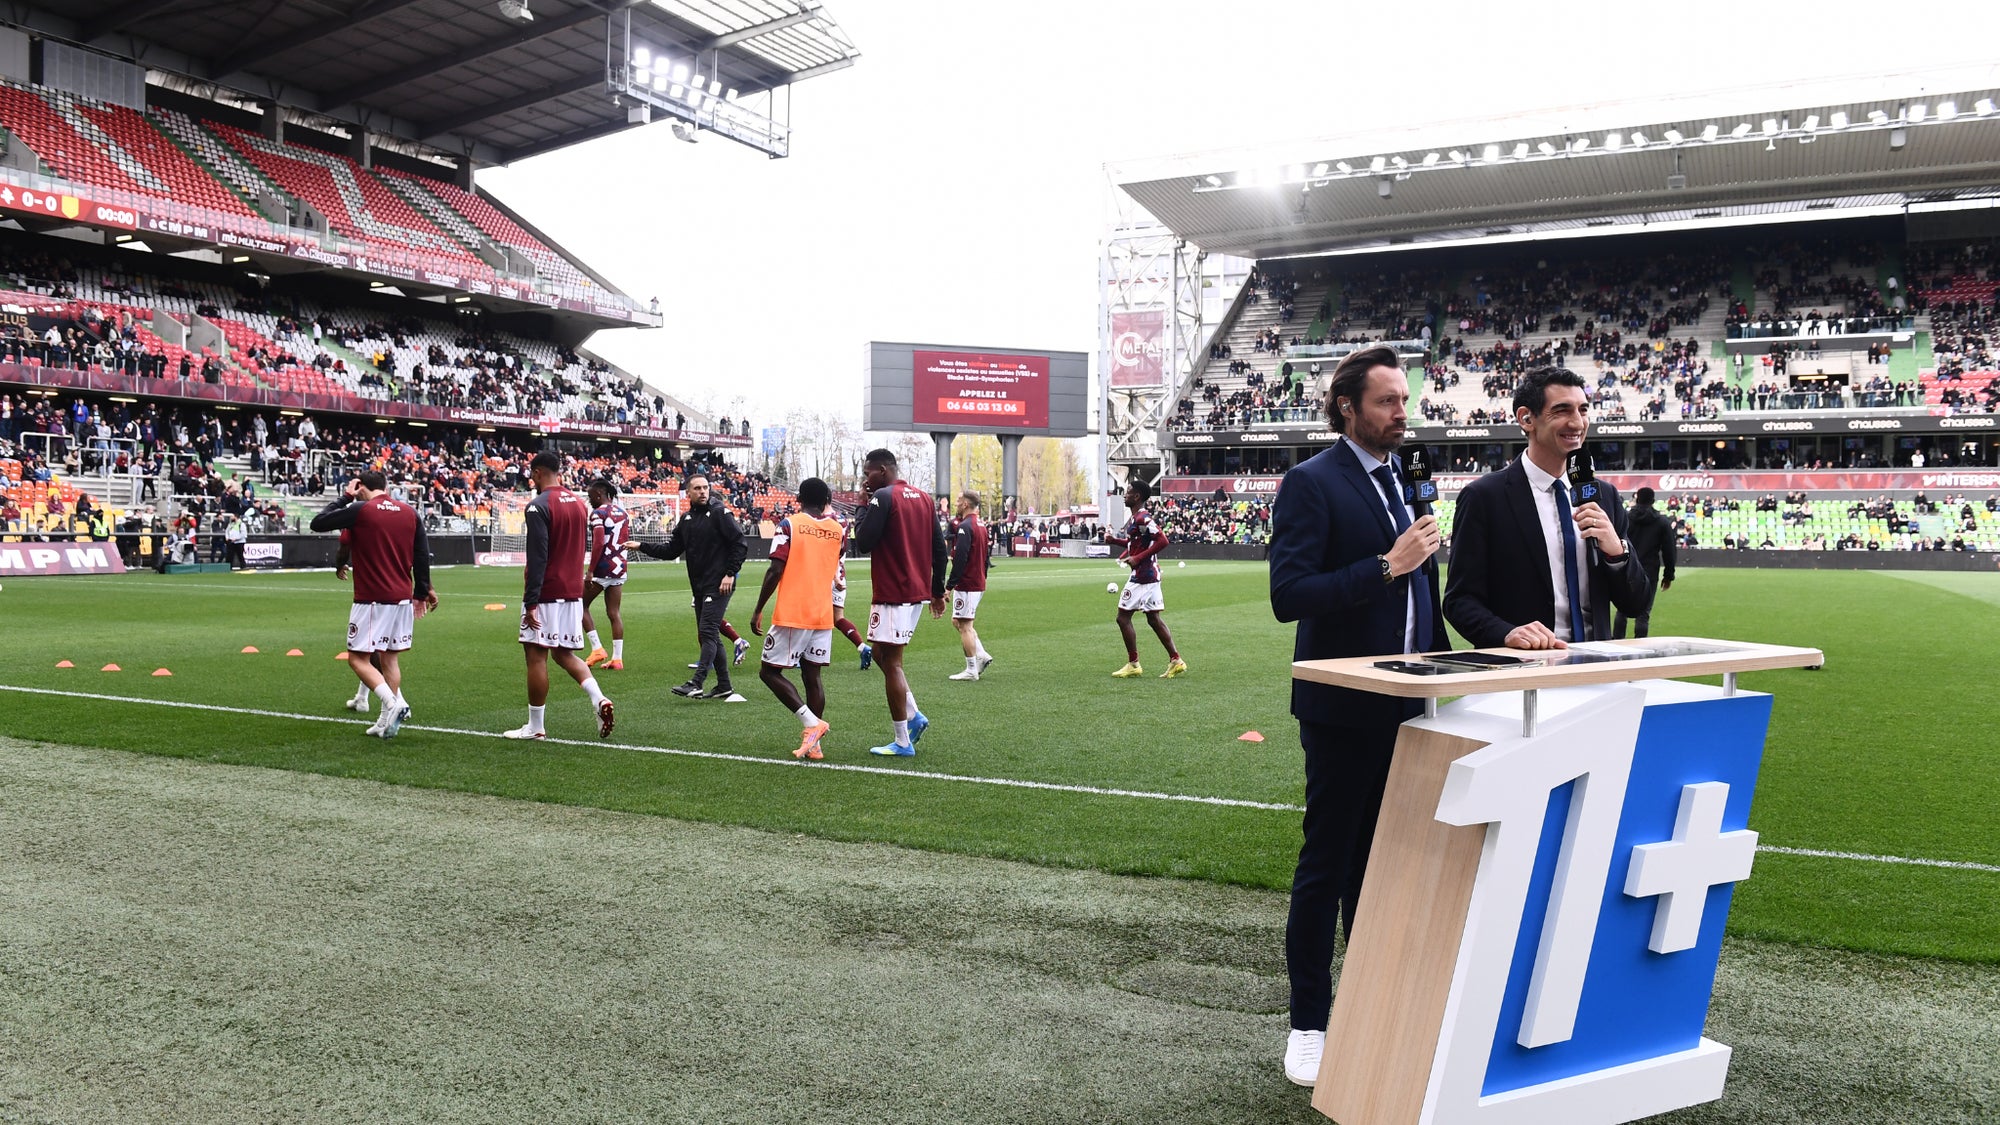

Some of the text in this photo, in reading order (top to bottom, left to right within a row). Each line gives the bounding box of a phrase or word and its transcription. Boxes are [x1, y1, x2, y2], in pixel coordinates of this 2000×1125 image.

[97, 206, 134, 225] 00:00
[310, 248, 348, 264] Kappa
[959, 390, 996, 398] APPELEZ
[947, 401, 1017, 412] 06 45 03 13 06
[450, 410, 459, 418] Le
[460, 410, 484, 421] Conseil
[1678, 423, 1726, 433] chaussea
[1762, 421, 1813, 432] chaussea
[1848, 419, 1901, 429] chaussea
[1940, 418, 1995, 428] chaussea
[1446, 428, 1489, 438] chaussea
[1597, 424, 1644, 434] chaussea
[1177, 435, 1214, 443] chaussea
[1240, 434, 1278, 442] chaussea
[1936, 474, 2000, 486] INTERSP
[1248, 481, 1276, 490] uem
[799, 524, 840, 540] Kappa
[810, 646, 826, 656] LCR
